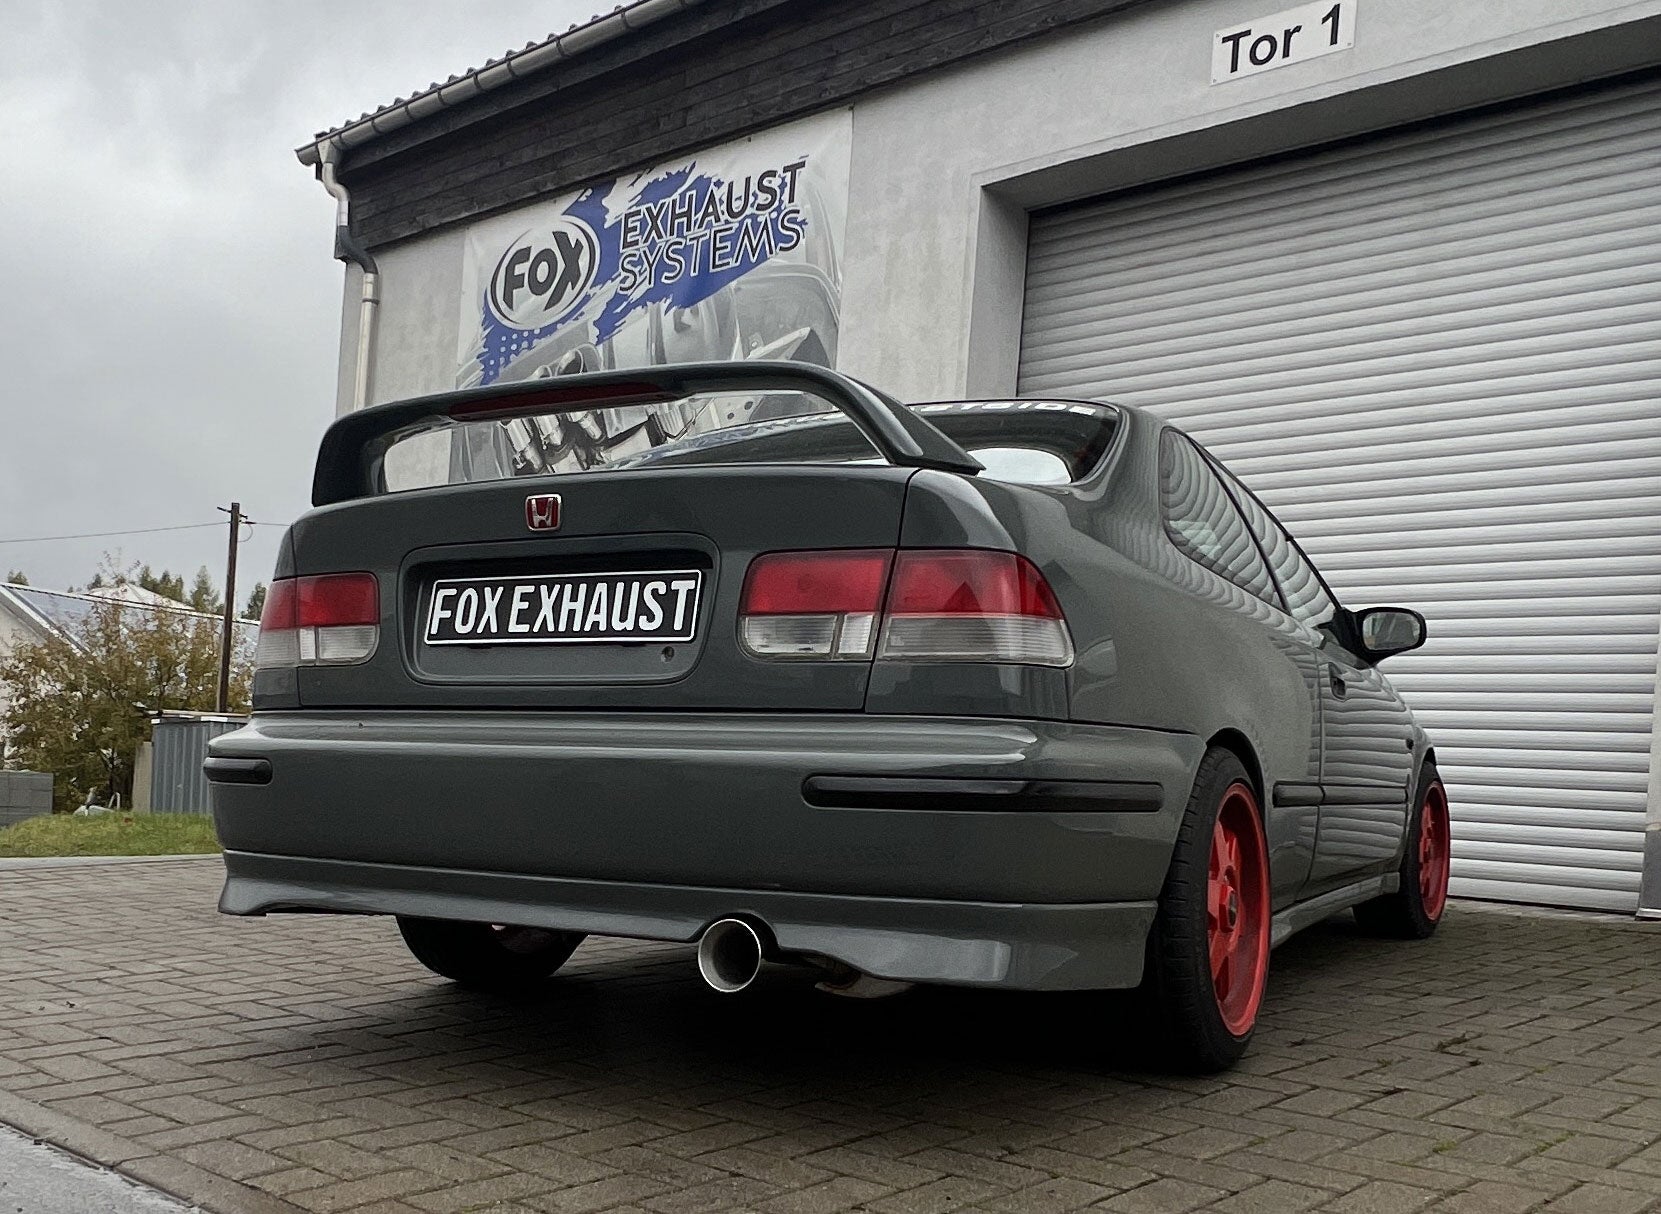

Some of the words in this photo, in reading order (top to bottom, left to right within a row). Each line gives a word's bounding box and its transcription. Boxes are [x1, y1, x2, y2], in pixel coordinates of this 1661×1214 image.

[1221, 24, 1302, 73] Tor
[1321, 3, 1341, 46] 1
[621, 160, 806, 249] EXHAUST
[503, 230, 584, 311] FOX
[619, 209, 802, 292] SYSTEMS
[430, 586, 503, 635] FOX
[508, 580, 696, 633] EXHAUST
